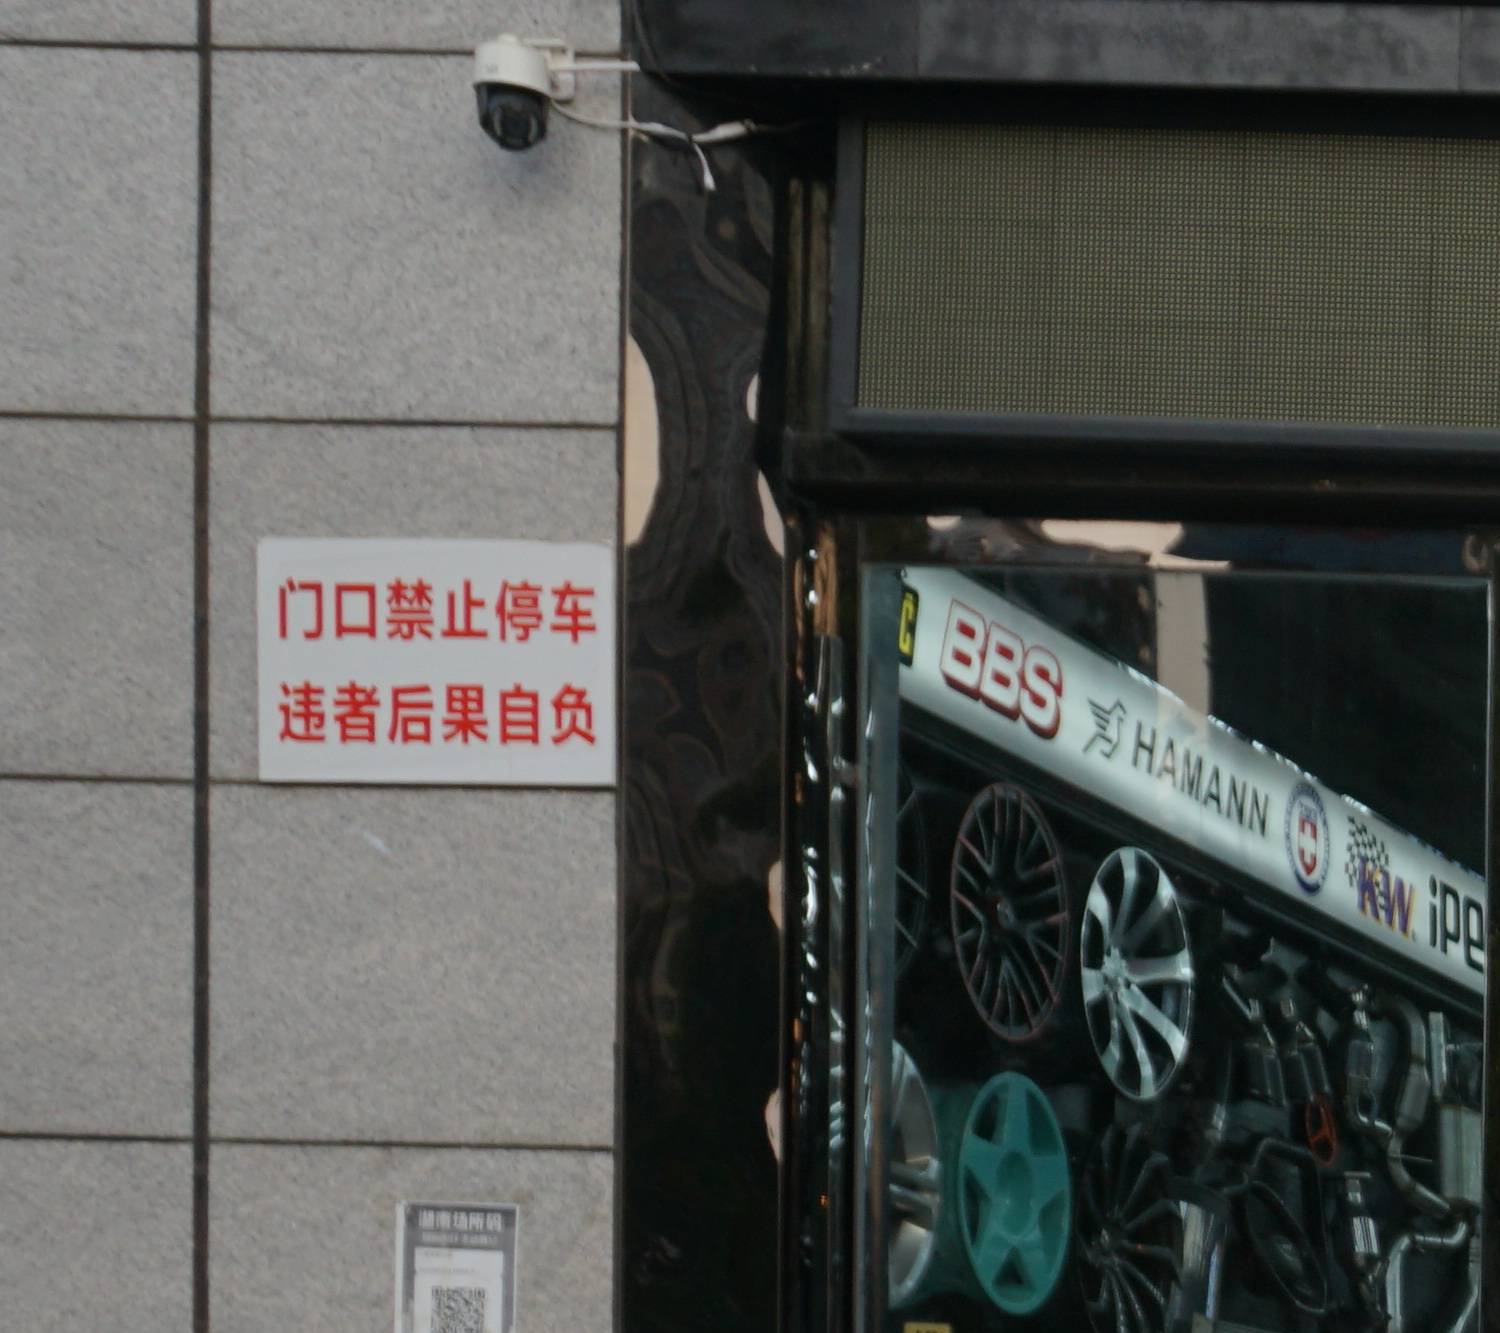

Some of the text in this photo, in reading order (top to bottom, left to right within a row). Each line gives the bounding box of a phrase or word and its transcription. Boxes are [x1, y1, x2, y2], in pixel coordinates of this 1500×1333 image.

[278, 577, 597, 643] 门口禁止停车
[278, 680, 597, 747] 违者后果自负
[939, 598, 1062, 739] BBS
[1132, 720, 1269, 837] HAMANN
